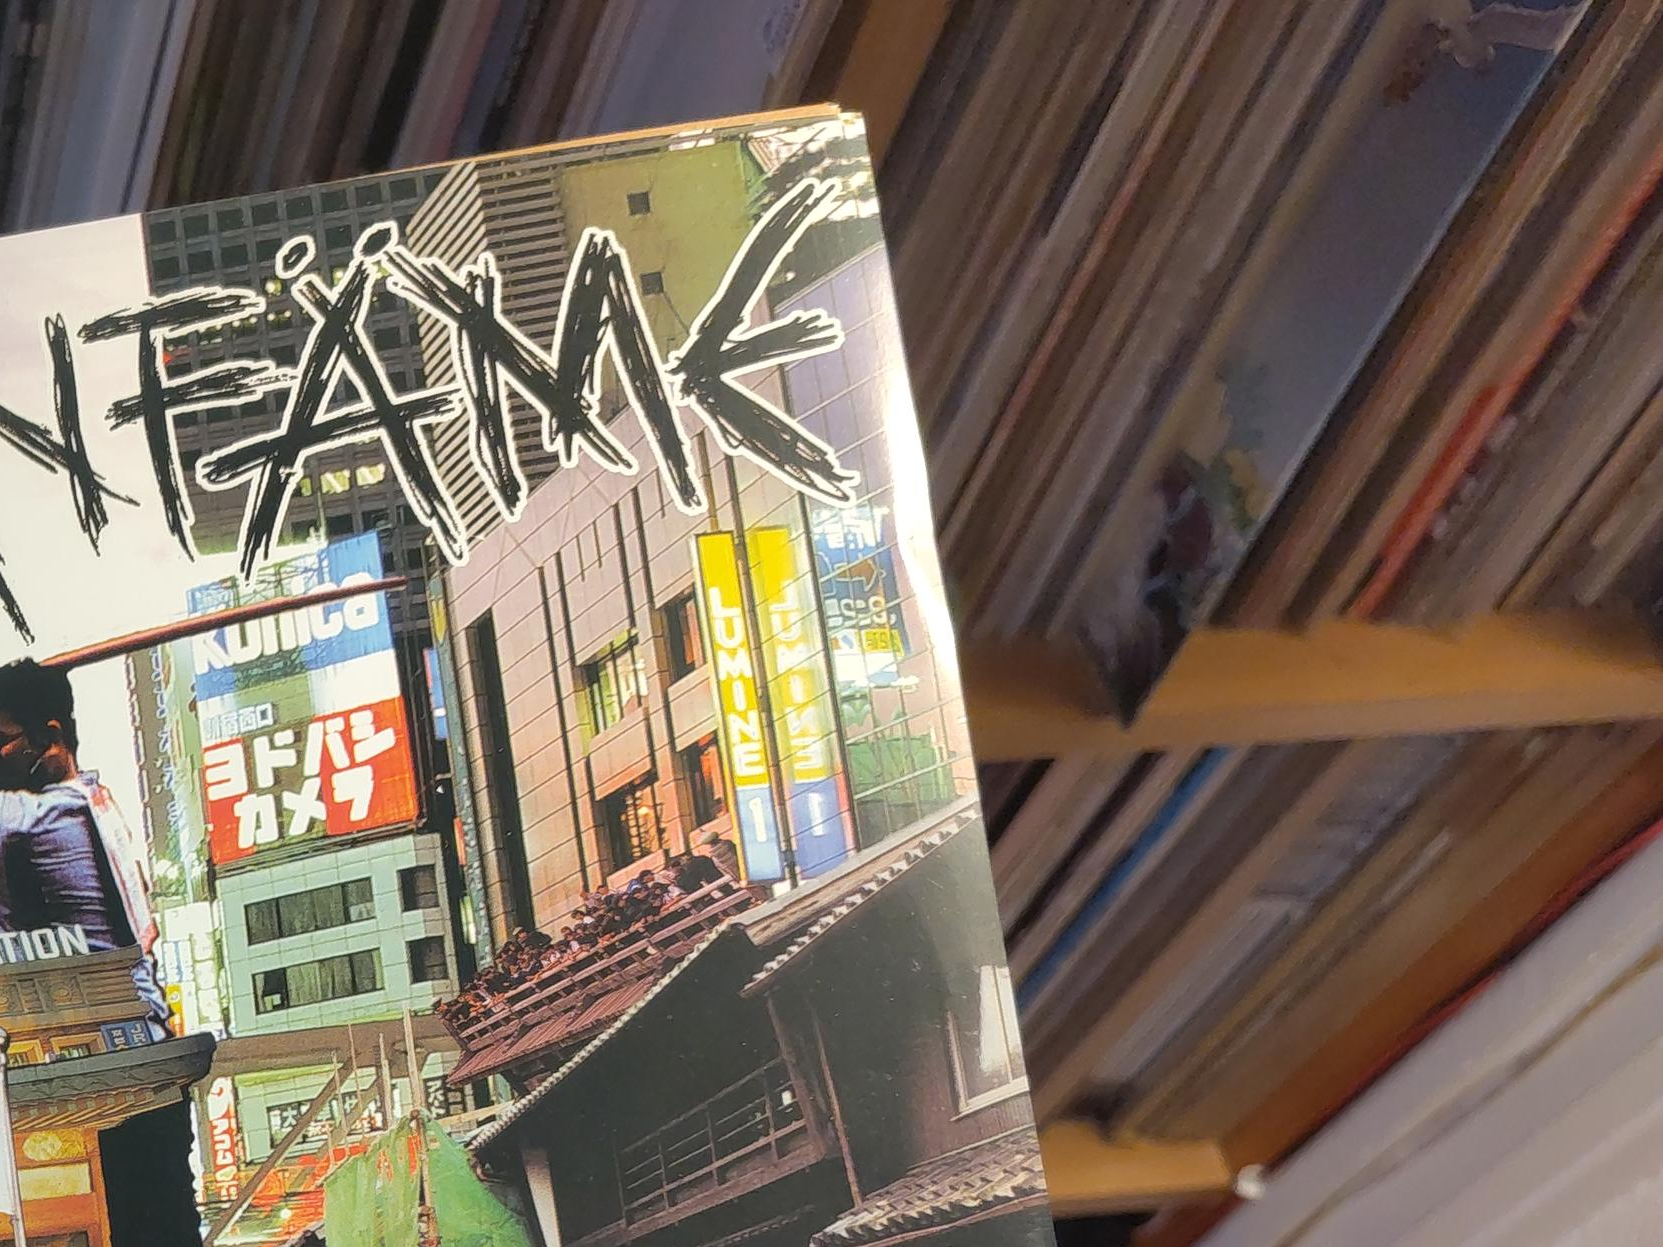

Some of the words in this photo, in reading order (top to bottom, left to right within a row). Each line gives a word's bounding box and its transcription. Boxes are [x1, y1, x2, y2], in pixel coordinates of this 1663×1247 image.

[203, 709, 396, 802] ヨドバシ
[233, 764, 375, 850] カメラ
